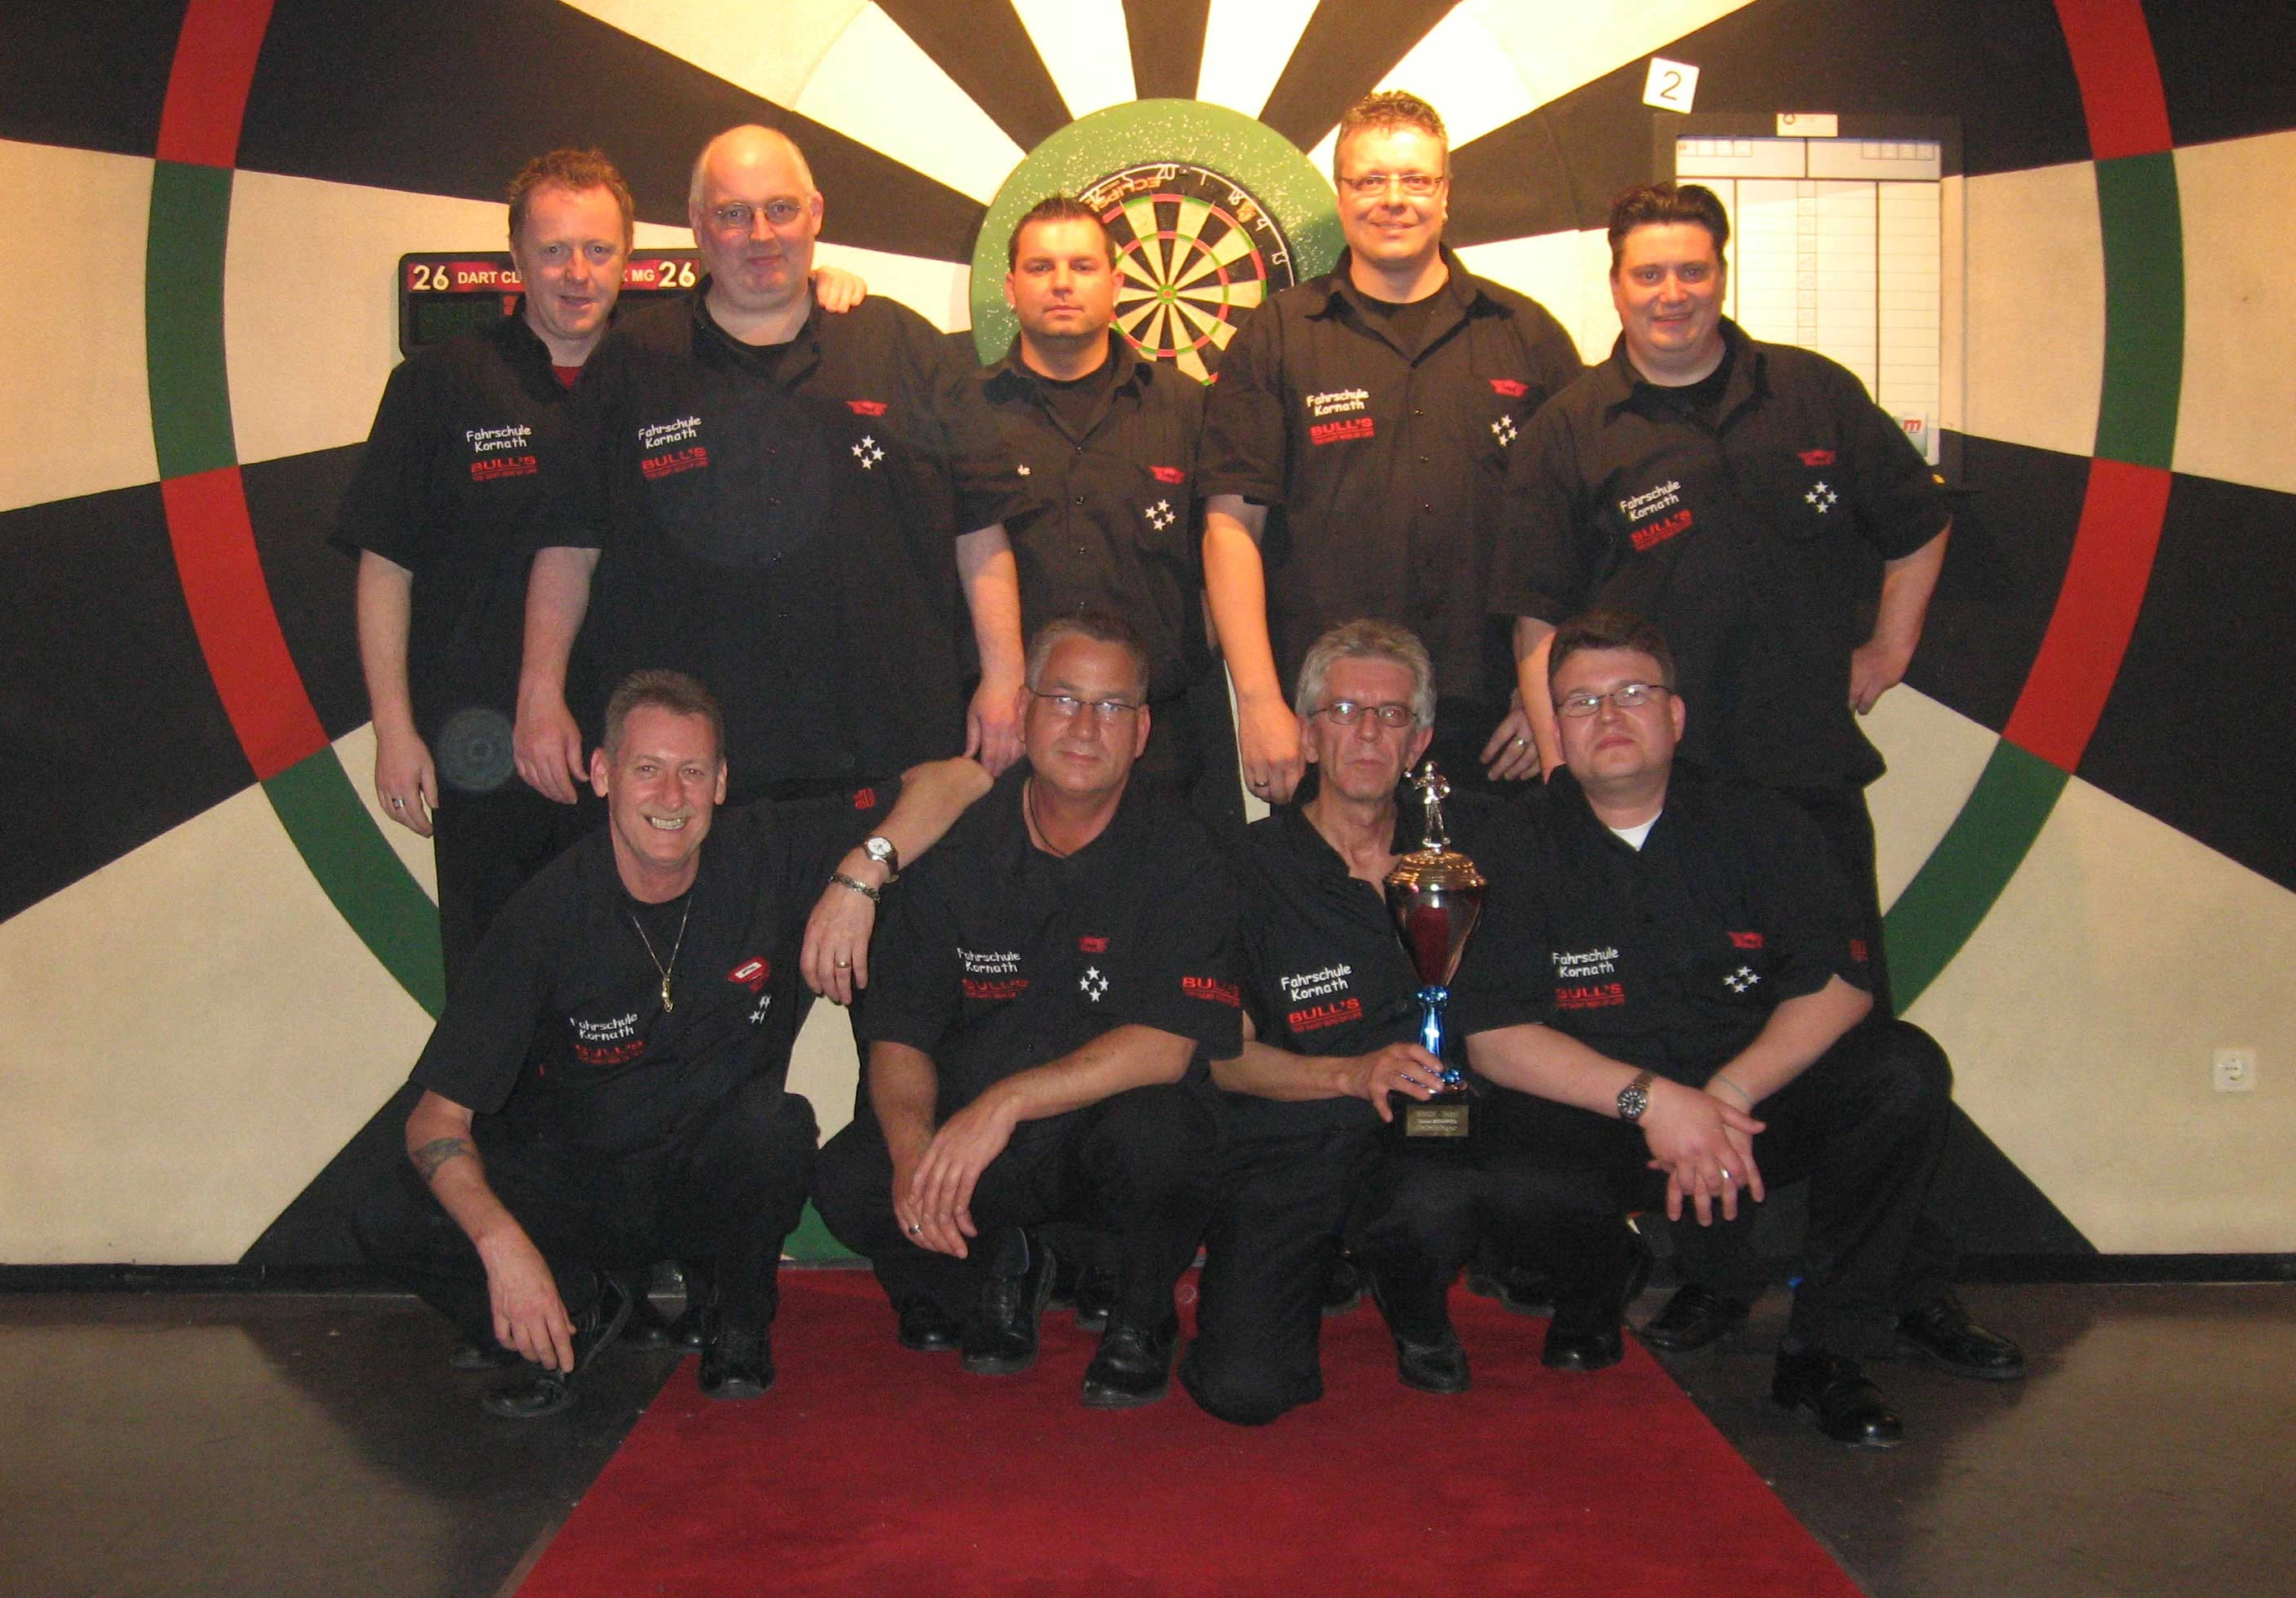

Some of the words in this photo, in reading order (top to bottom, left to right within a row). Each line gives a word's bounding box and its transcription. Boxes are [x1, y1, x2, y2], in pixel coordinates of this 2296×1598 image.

[1660, 71, 1682, 100] 2
[1156, 166, 1176, 181] 20
[412, 264, 449, 291] 26
[457, 271, 497, 285] DART
[501, 270, 521, 284] CL
[631, 269, 655, 282] MG
[658, 261, 695, 288] 26
[1306, 388, 1369, 408] Fahrschule
[1314, 400, 1365, 417] Kornath
[466, 424, 532, 443] Fahrschule
[638, 416, 702, 439] Fahrschule
[1309, 417, 1373, 435] BULL'S
[475, 437, 528, 453] Kornath
[646, 428, 697, 449] Kornath
[470, 455, 536, 473] BULL'S
[641, 447, 708, 471] BULL'S
[1618, 480, 1681, 514] Fahrschule
[1630, 493, 1680, 522] Kornath
[956, 947, 1022, 962] Fahrschule
[1552, 947, 1618, 965] Fahrschule
[965, 960, 1018, 973] Kornath
[1559, 960, 1614, 978] Kornath
[1281, 963, 1352, 991] Fahrschule
[1291, 978, 1349, 1002] Kornath
[1288, 998, 1360, 1024] BULL'S
[579, 1026, 635, 1041] Kornath
